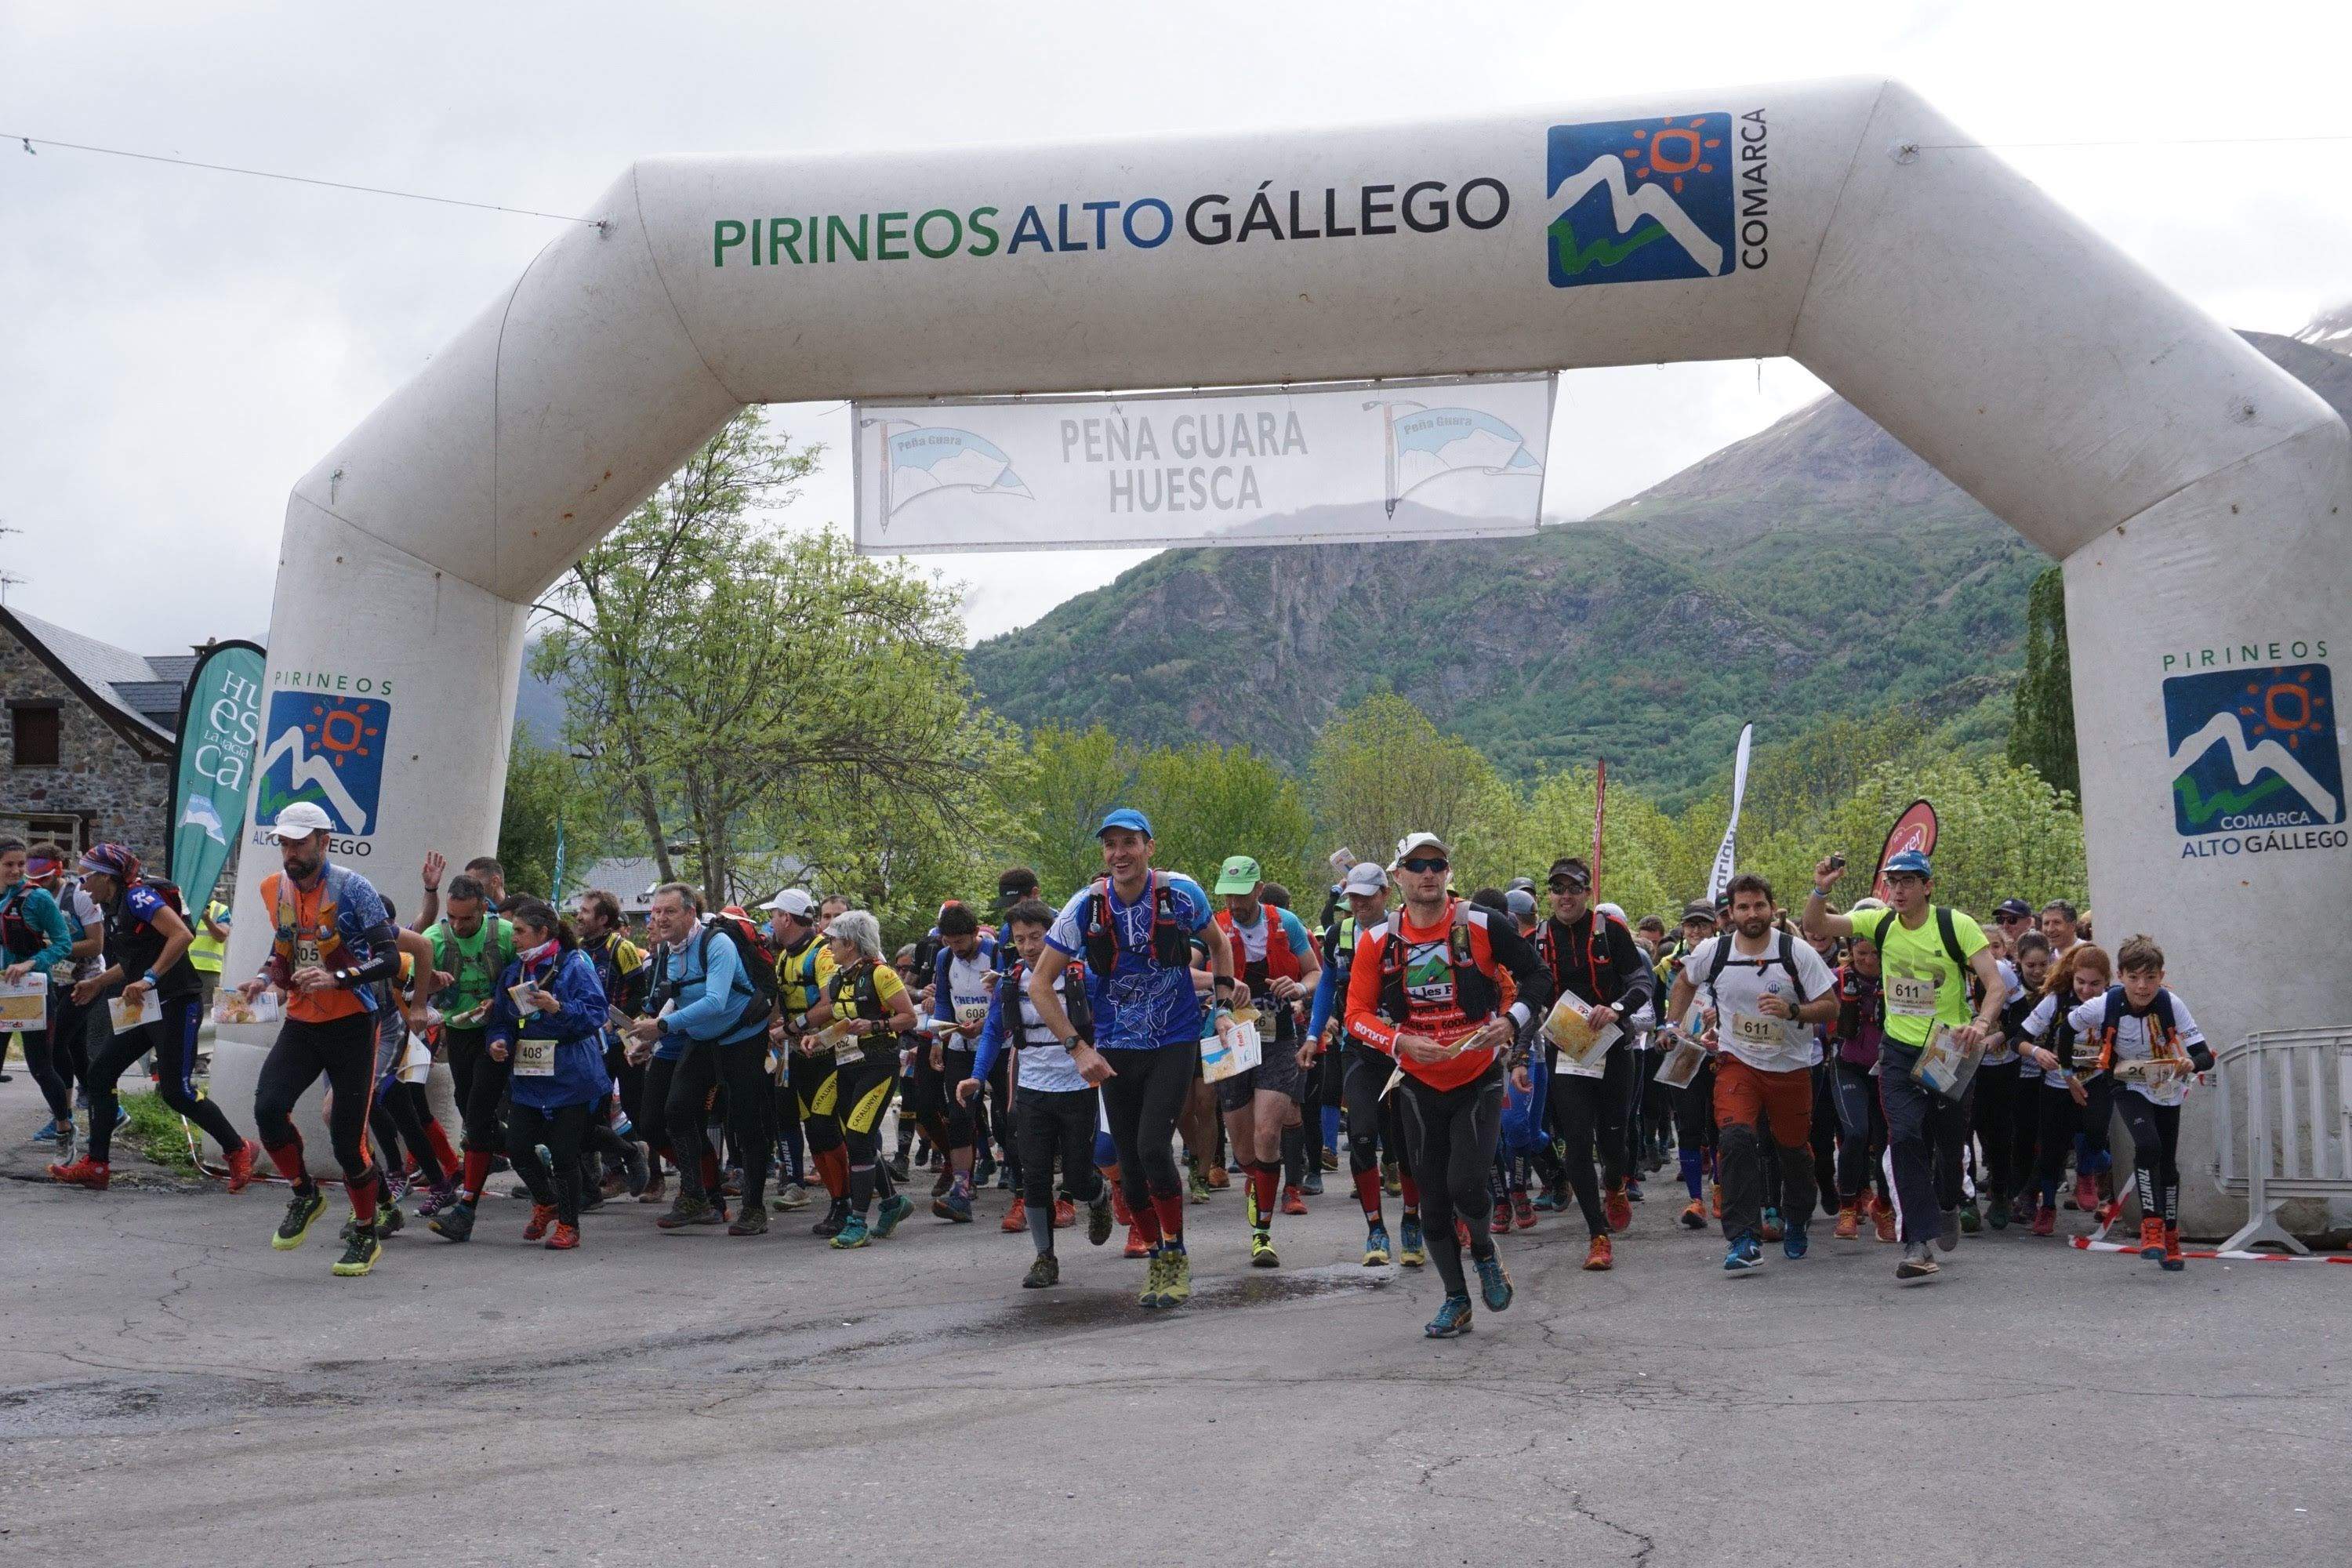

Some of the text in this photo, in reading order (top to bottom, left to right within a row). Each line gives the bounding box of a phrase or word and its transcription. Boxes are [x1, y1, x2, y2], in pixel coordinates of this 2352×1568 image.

[1742, 107, 1769, 270] COMARCA
[1172, 410, 1308, 459] GUARA
[1110, 465, 1263, 514] HUESCA
[2163, 641, 2328, 671] PIRINEOS
[275, 671, 392, 695] PIRINEOS
[2220, 811, 2311, 830] COMARCA
[297, 947, 318, 961] 05
[1896, 984, 1918, 998] 611
[966, 1008, 985, 1018] 608
[1744, 1022, 1768, 1035] 611
[814, 1078, 838, 1110] CATALUNY
[852, 1094, 879, 1127] CATALUNYA
[781, 1141, 793, 1177] TRIMTEX
[2138, 1168, 2154, 1212] TRIMTEX
[2165, 1185, 2177, 1220] TRIMTEX
